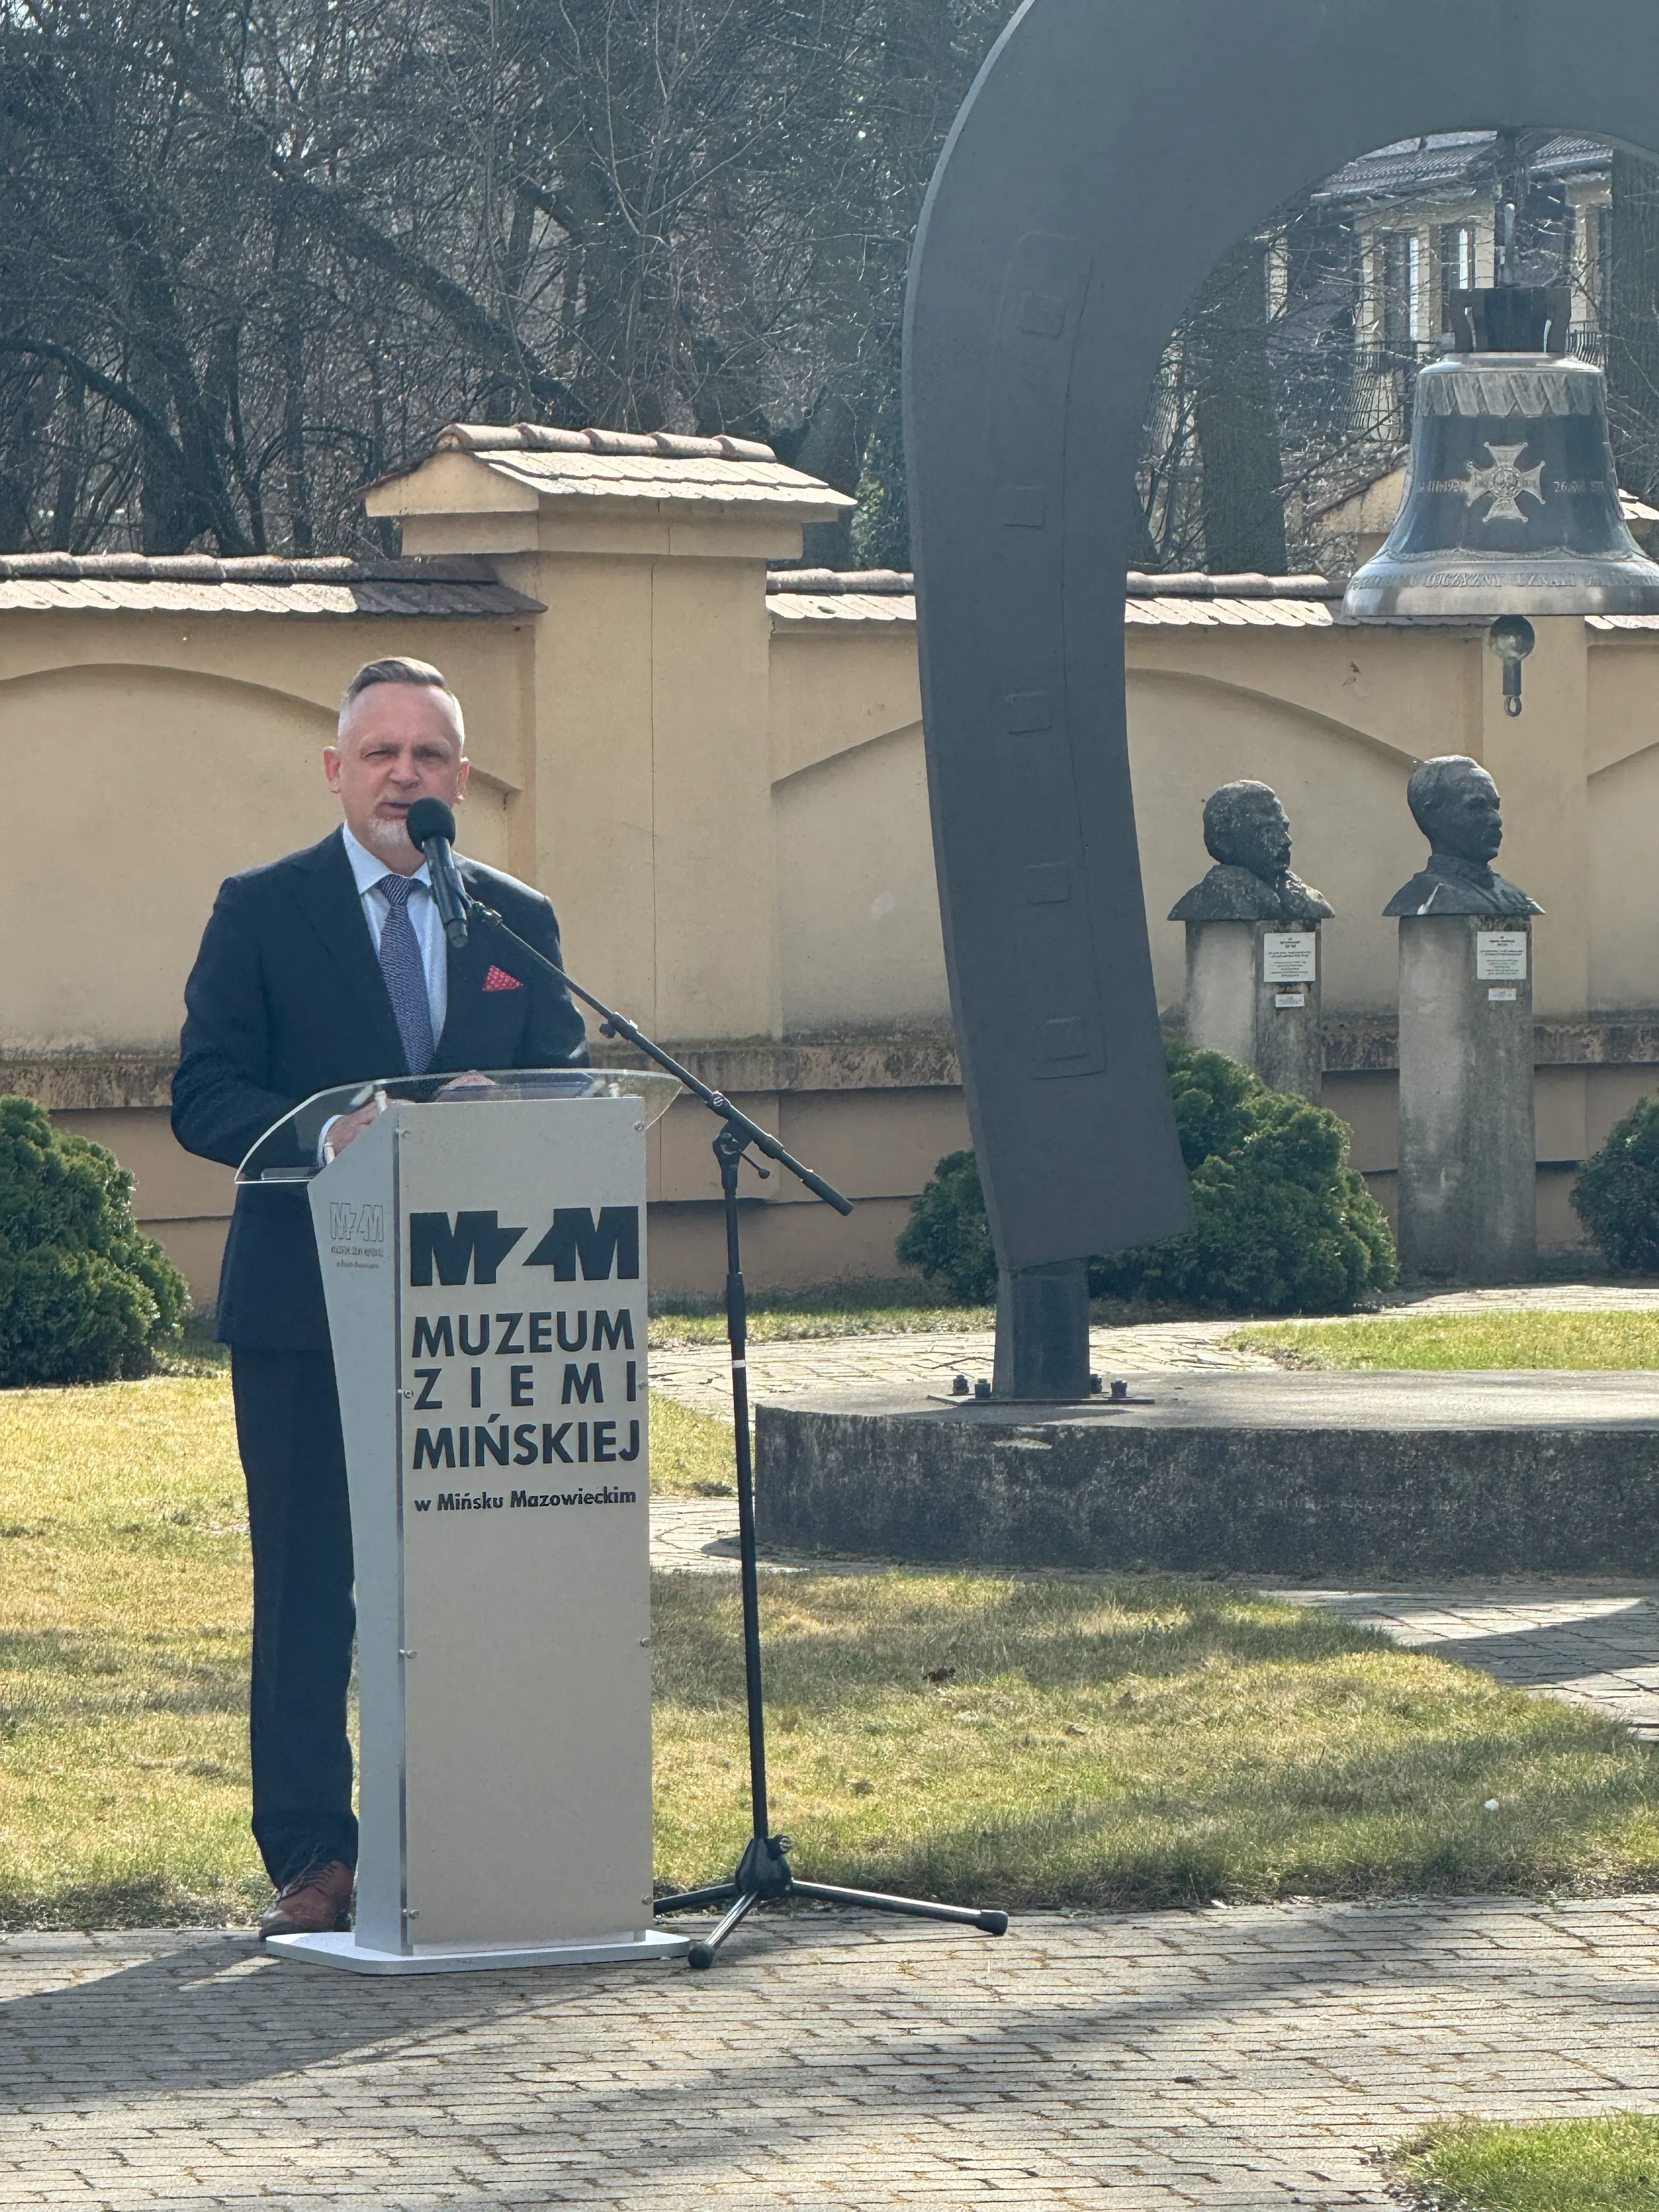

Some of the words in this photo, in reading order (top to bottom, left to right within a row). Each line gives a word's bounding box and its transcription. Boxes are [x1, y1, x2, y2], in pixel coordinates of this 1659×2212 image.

[411, 1308, 635, 1358] MUZEUM
[413, 1361, 636, 1410] ZIEMI
[412, 1413, 640, 1470] MIŃSKIEJ
[414, 1499, 432, 1512] w
[437, 1491, 504, 1511] Mińsku
[510, 1486, 636, 1508] Mazowieckim
